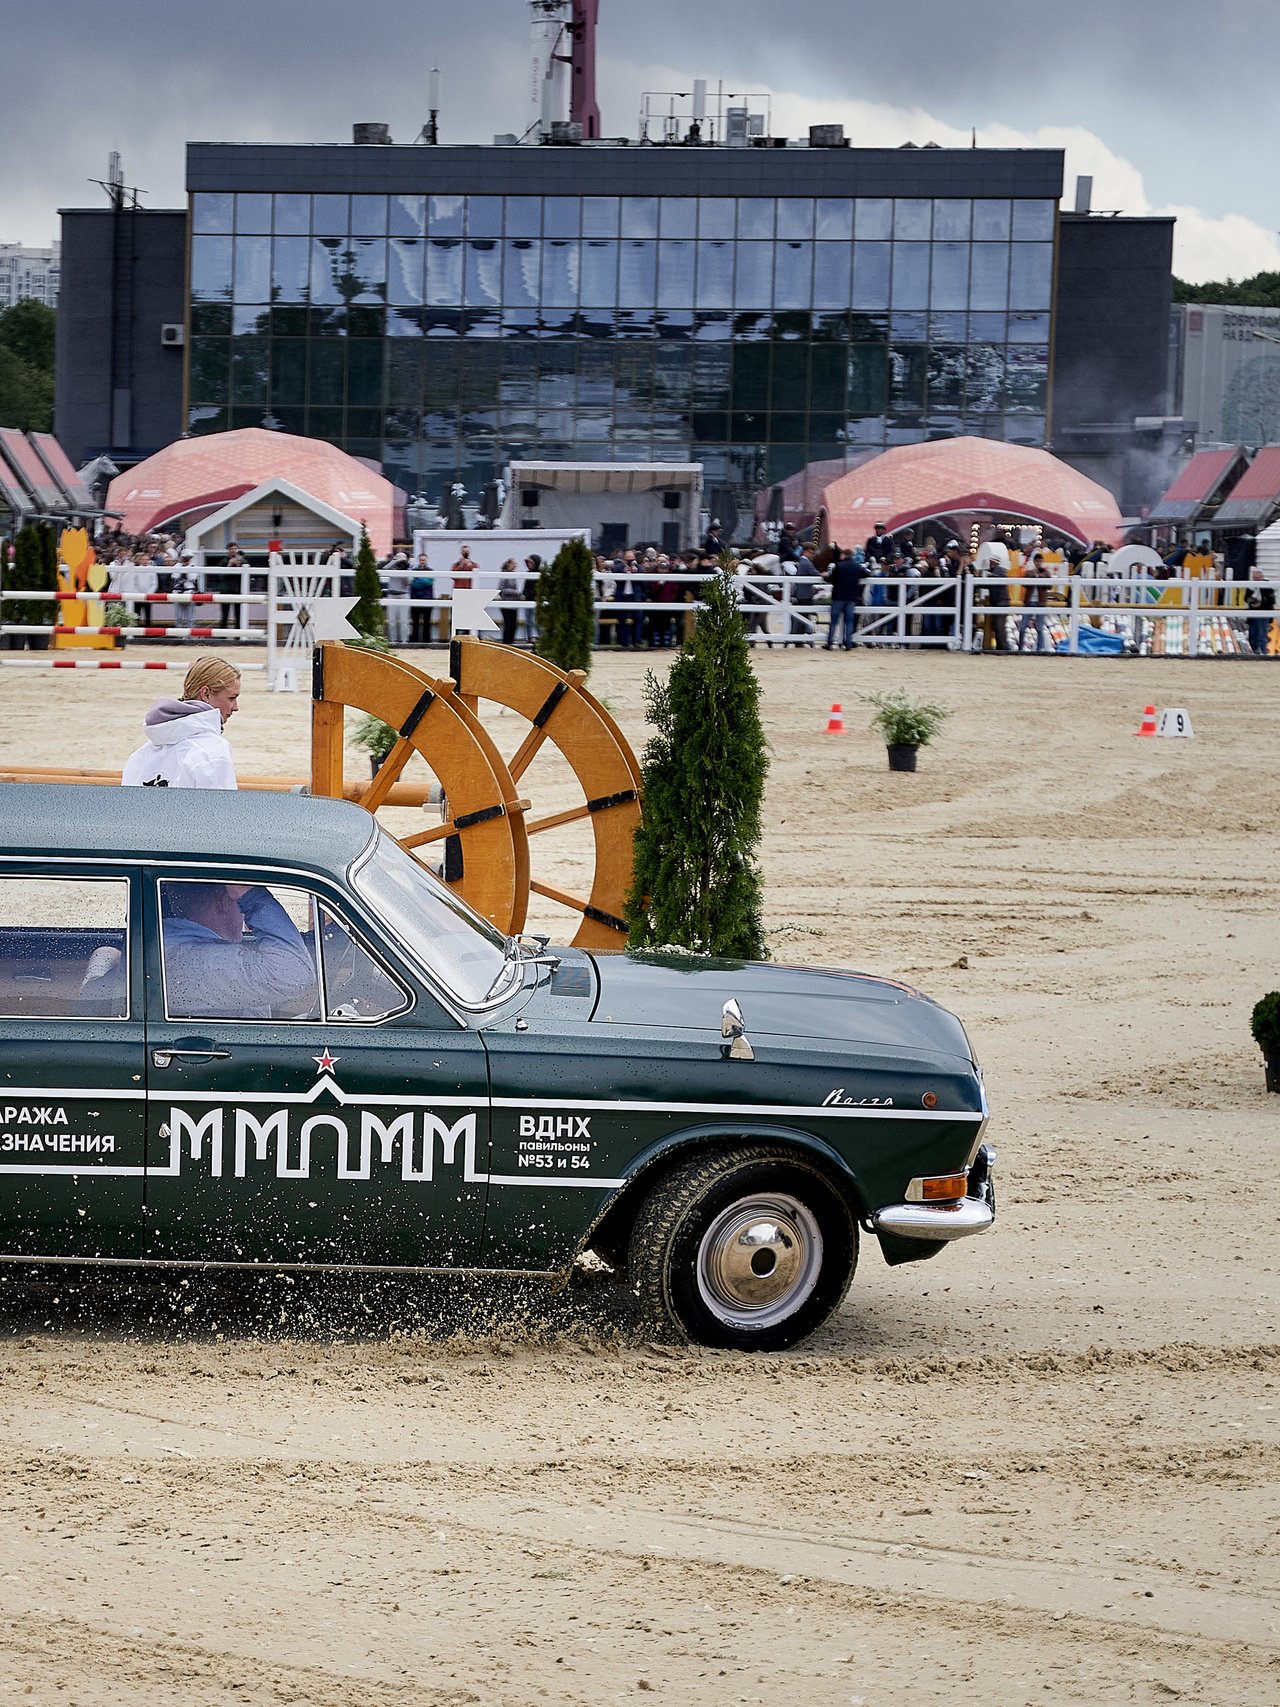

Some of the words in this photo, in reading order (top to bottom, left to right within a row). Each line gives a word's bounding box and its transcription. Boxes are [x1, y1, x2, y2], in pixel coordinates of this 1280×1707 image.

[1176, 713, 1184, 732] 9
[519, 1115, 592, 1140] ВДНХ
[519, 1142, 591, 1152] павильоны
[518, 1154, 554, 1168] №53
[557, 1158, 567, 1168] и
[570, 1155, 591, 1169] 54
